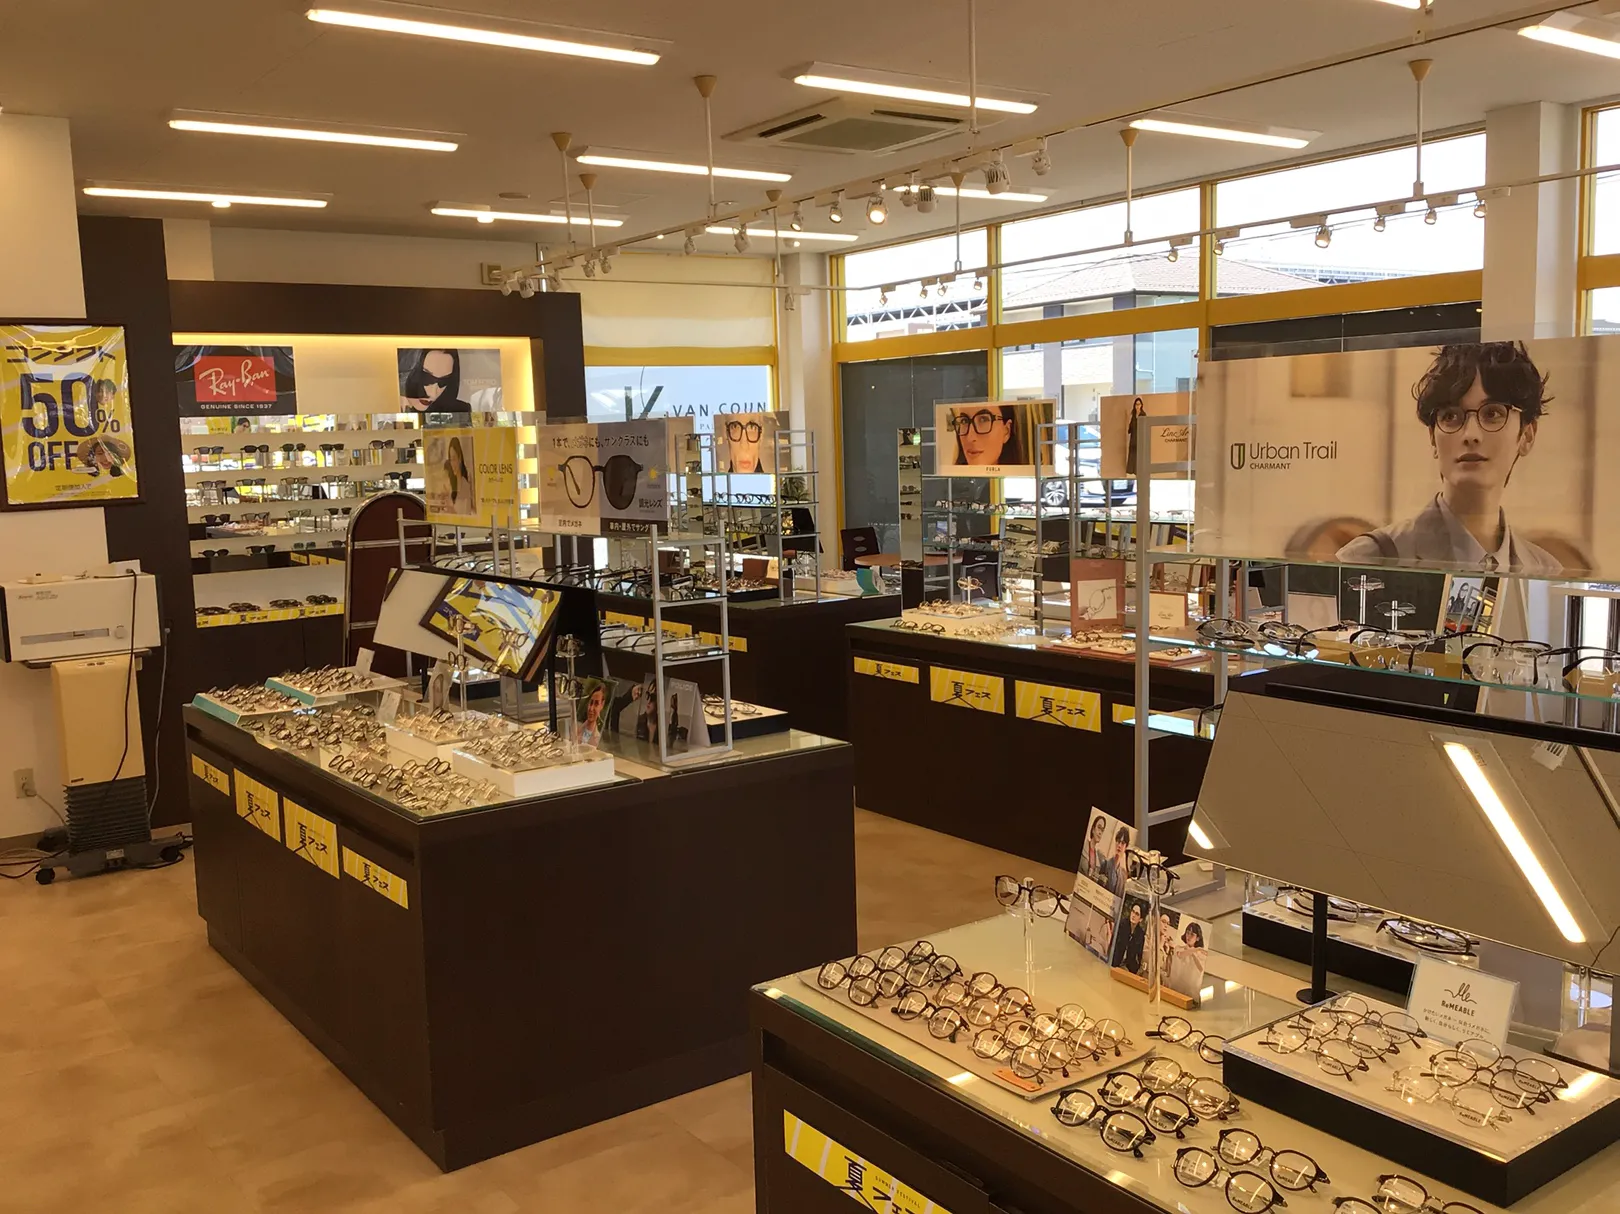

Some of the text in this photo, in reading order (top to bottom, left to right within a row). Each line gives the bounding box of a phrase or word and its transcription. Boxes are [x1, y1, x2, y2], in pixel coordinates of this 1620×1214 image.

[199, 359, 270, 397] Ray-Ban
[673, 404, 709, 418] VAN
[28, 441, 79, 472] OFF
[1249, 440, 1337, 460] Urban Trail
[479, 463, 513, 474] COLOR LENS
[1249, 462, 1291, 470] CHARMANT
[948, 680, 992, 702] 夏フェス
[1036, 695, 1087, 719] 夏フェス
[295, 821, 329, 856] 夏フェス
[1441, 1000, 1476, 1017] ReMEABLE
